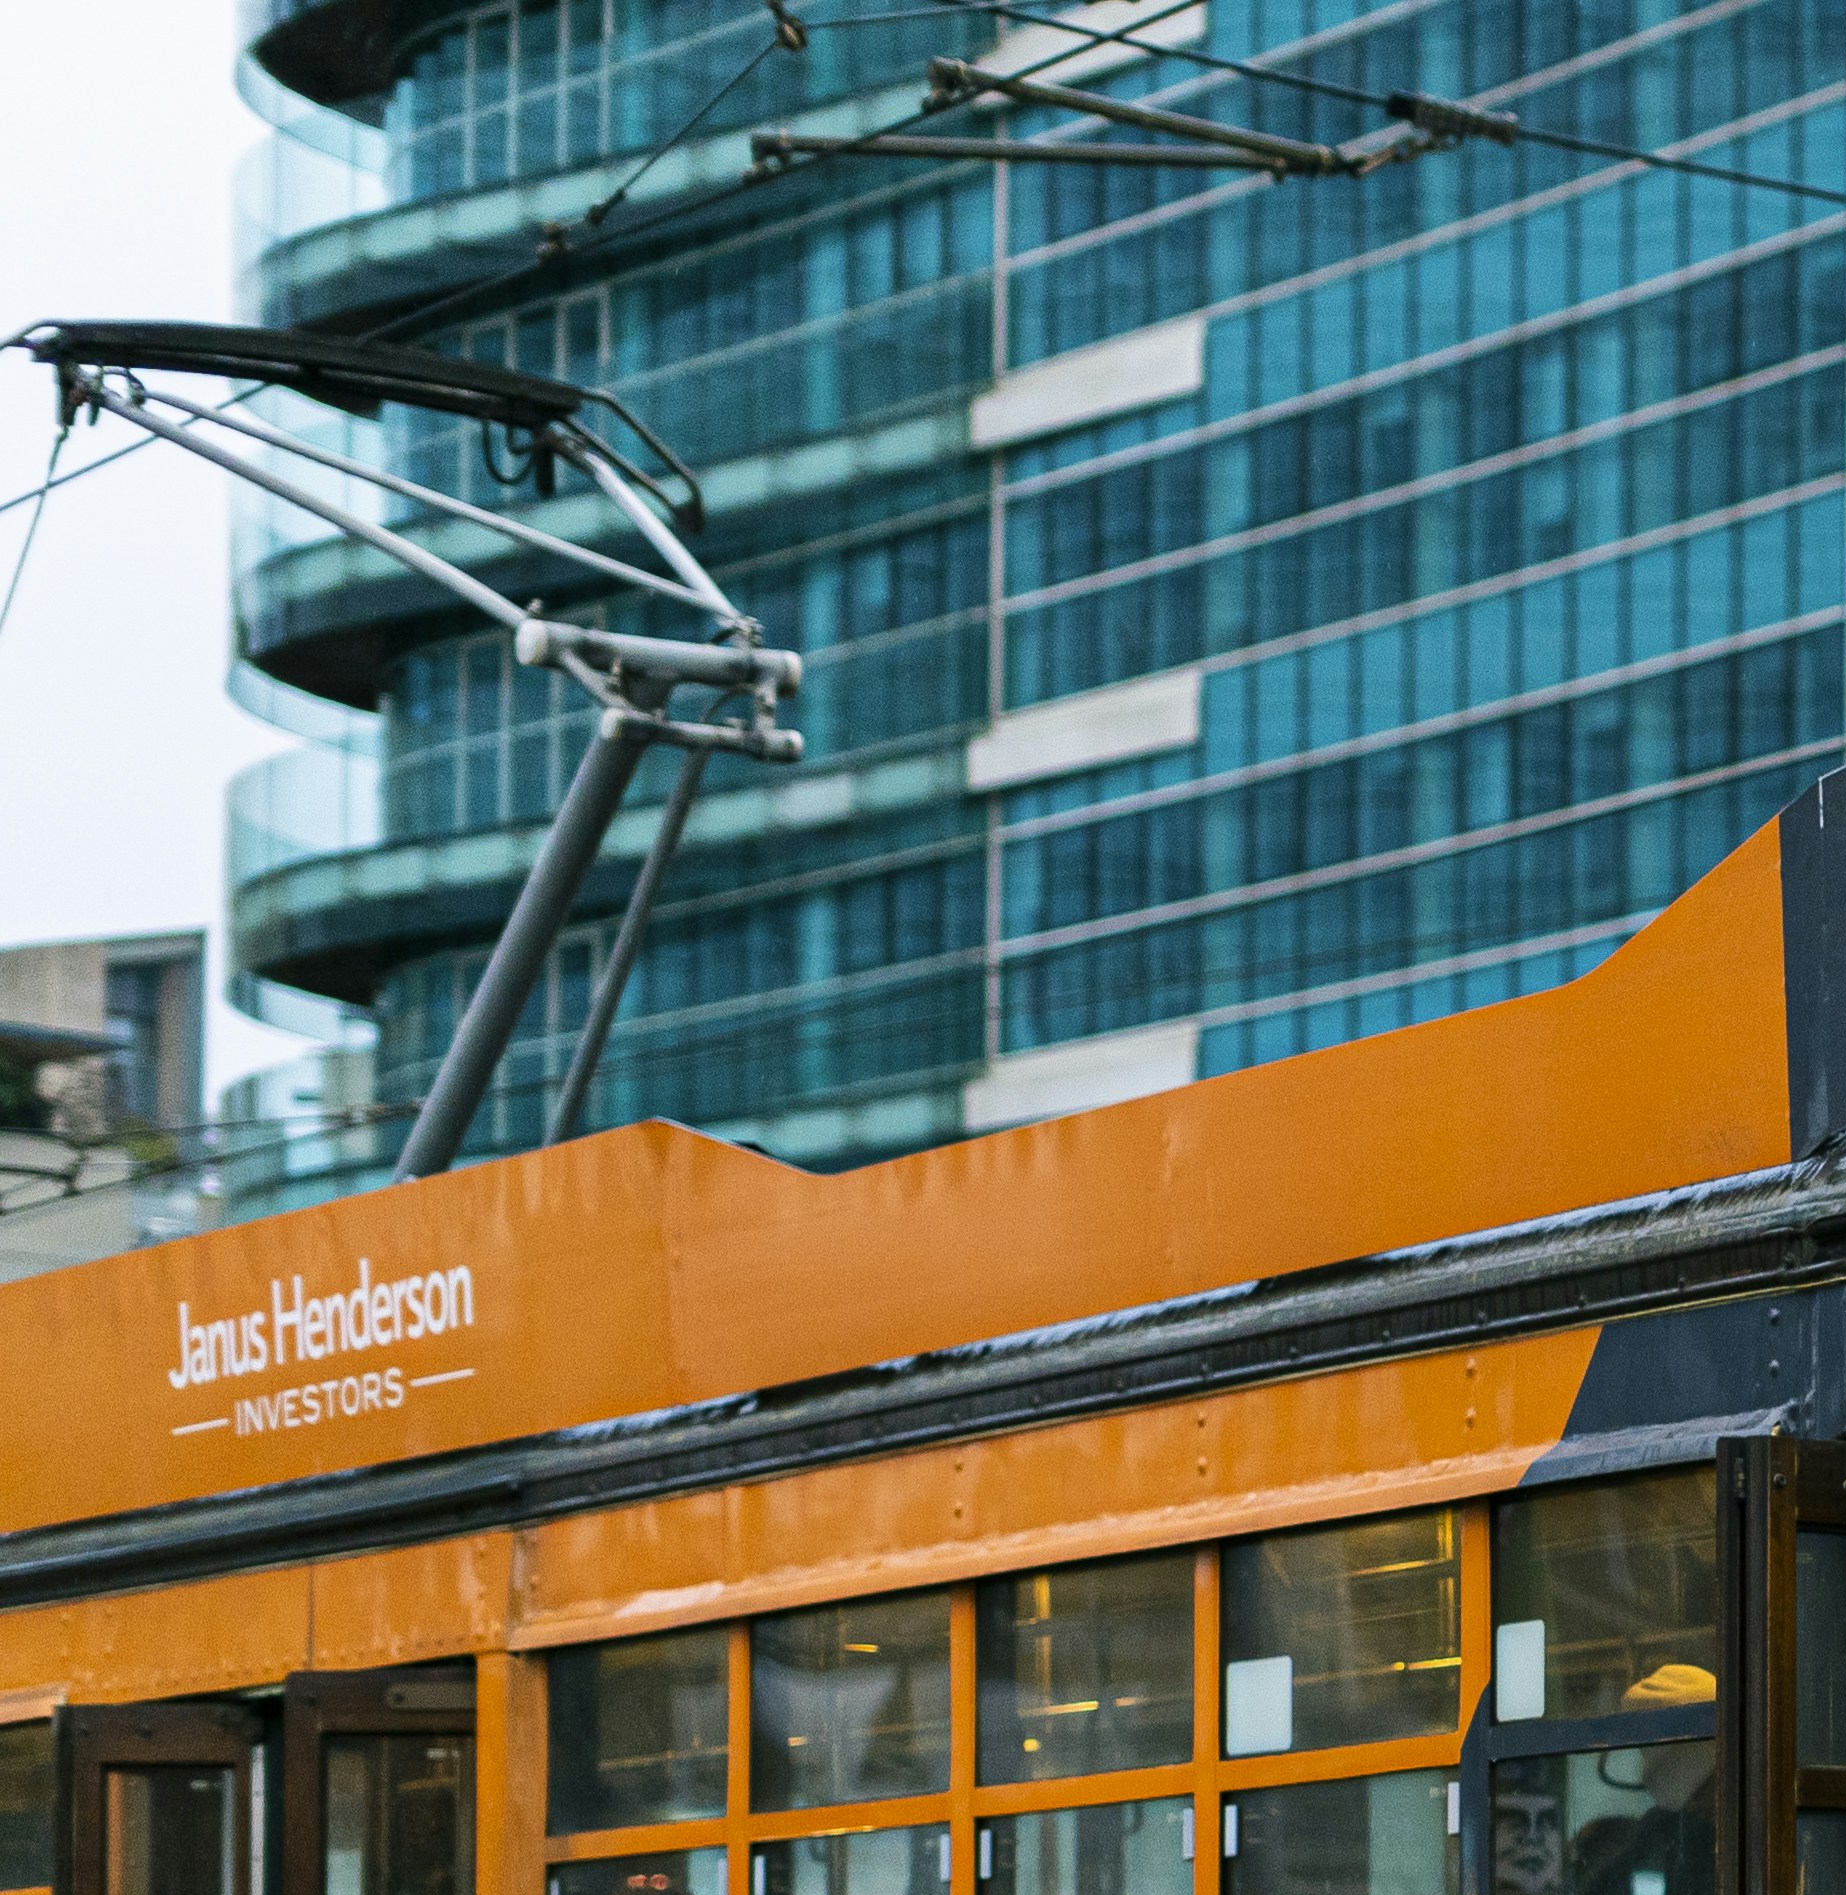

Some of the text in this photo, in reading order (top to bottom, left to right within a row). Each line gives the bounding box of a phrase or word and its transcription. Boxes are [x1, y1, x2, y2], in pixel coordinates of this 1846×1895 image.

[168, 1257, 476, 1390] Janus Henderson
[233, 1367, 404, 1437] INVESTORS
